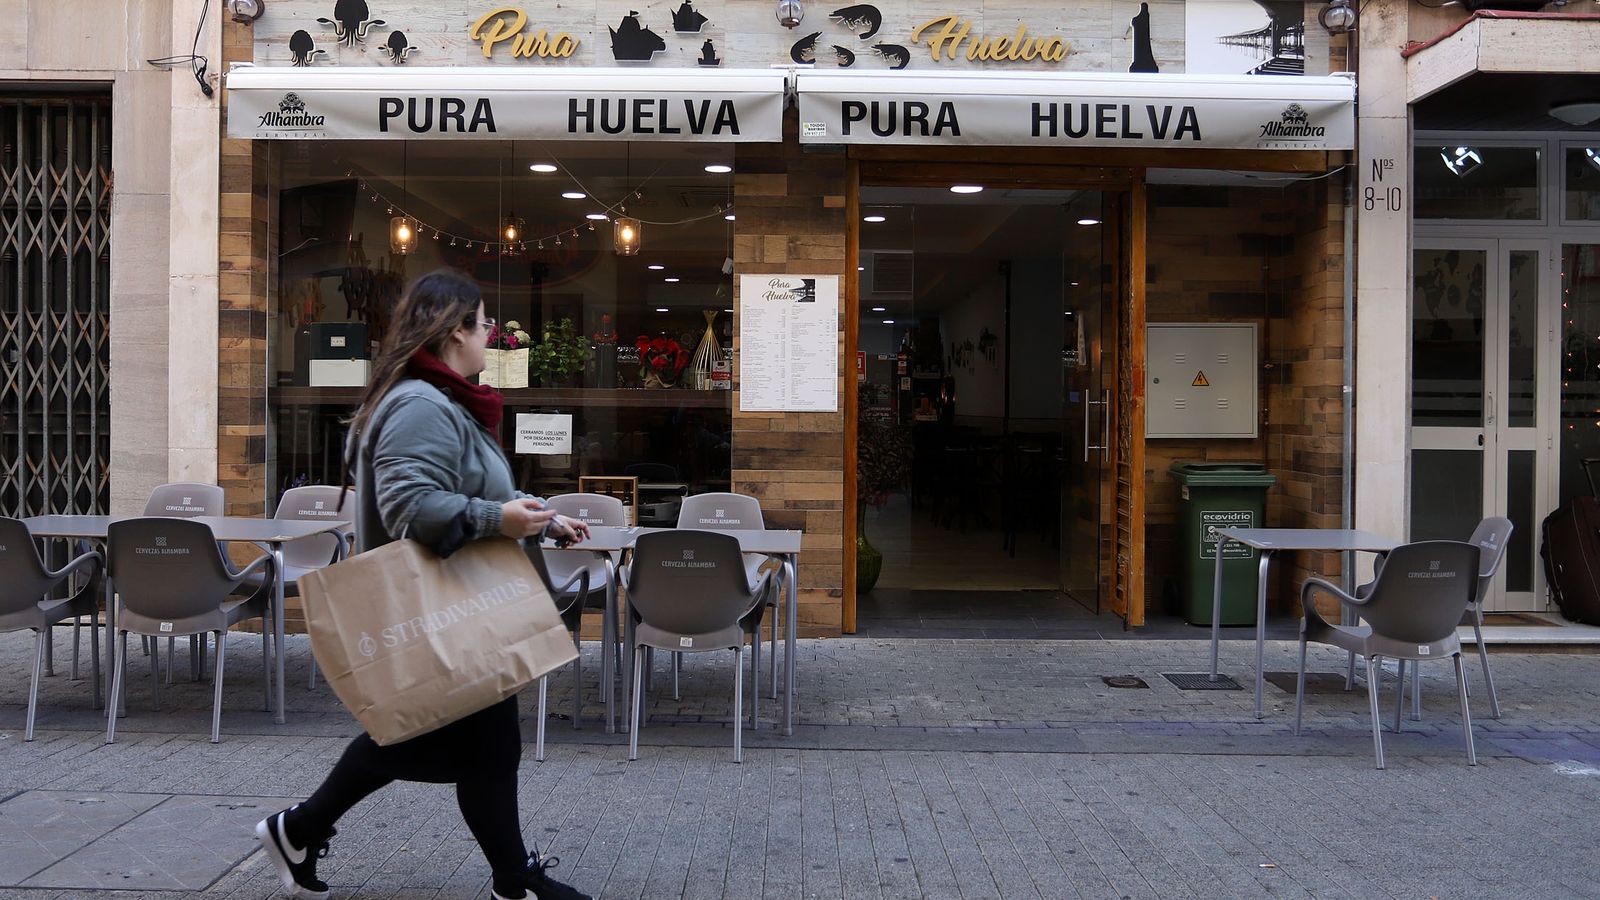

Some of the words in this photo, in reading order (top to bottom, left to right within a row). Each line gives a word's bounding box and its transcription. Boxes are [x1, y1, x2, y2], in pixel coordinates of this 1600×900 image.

[470, 7, 580, 58] Pura
[911, 15, 1072, 61] Huelva
[257, 112, 325, 128] Alhambra
[379, 97, 497, 134] PURA
[568, 98, 741, 135] HUELVA
[841, 100, 961, 137] PURA
[1031, 102, 1203, 141] HUELVA
[1259, 121, 1325, 137] Alhambra
[1364, 187, 1401, 211] 8-10
[768, 278, 791, 289] Pura
[762, 291, 797, 302] Huelva
[1203, 512, 1251, 520] ecovidrio
[661, 560, 687, 568] CERVEZAS
[381, 576, 531, 648] STRADIVARIUS
